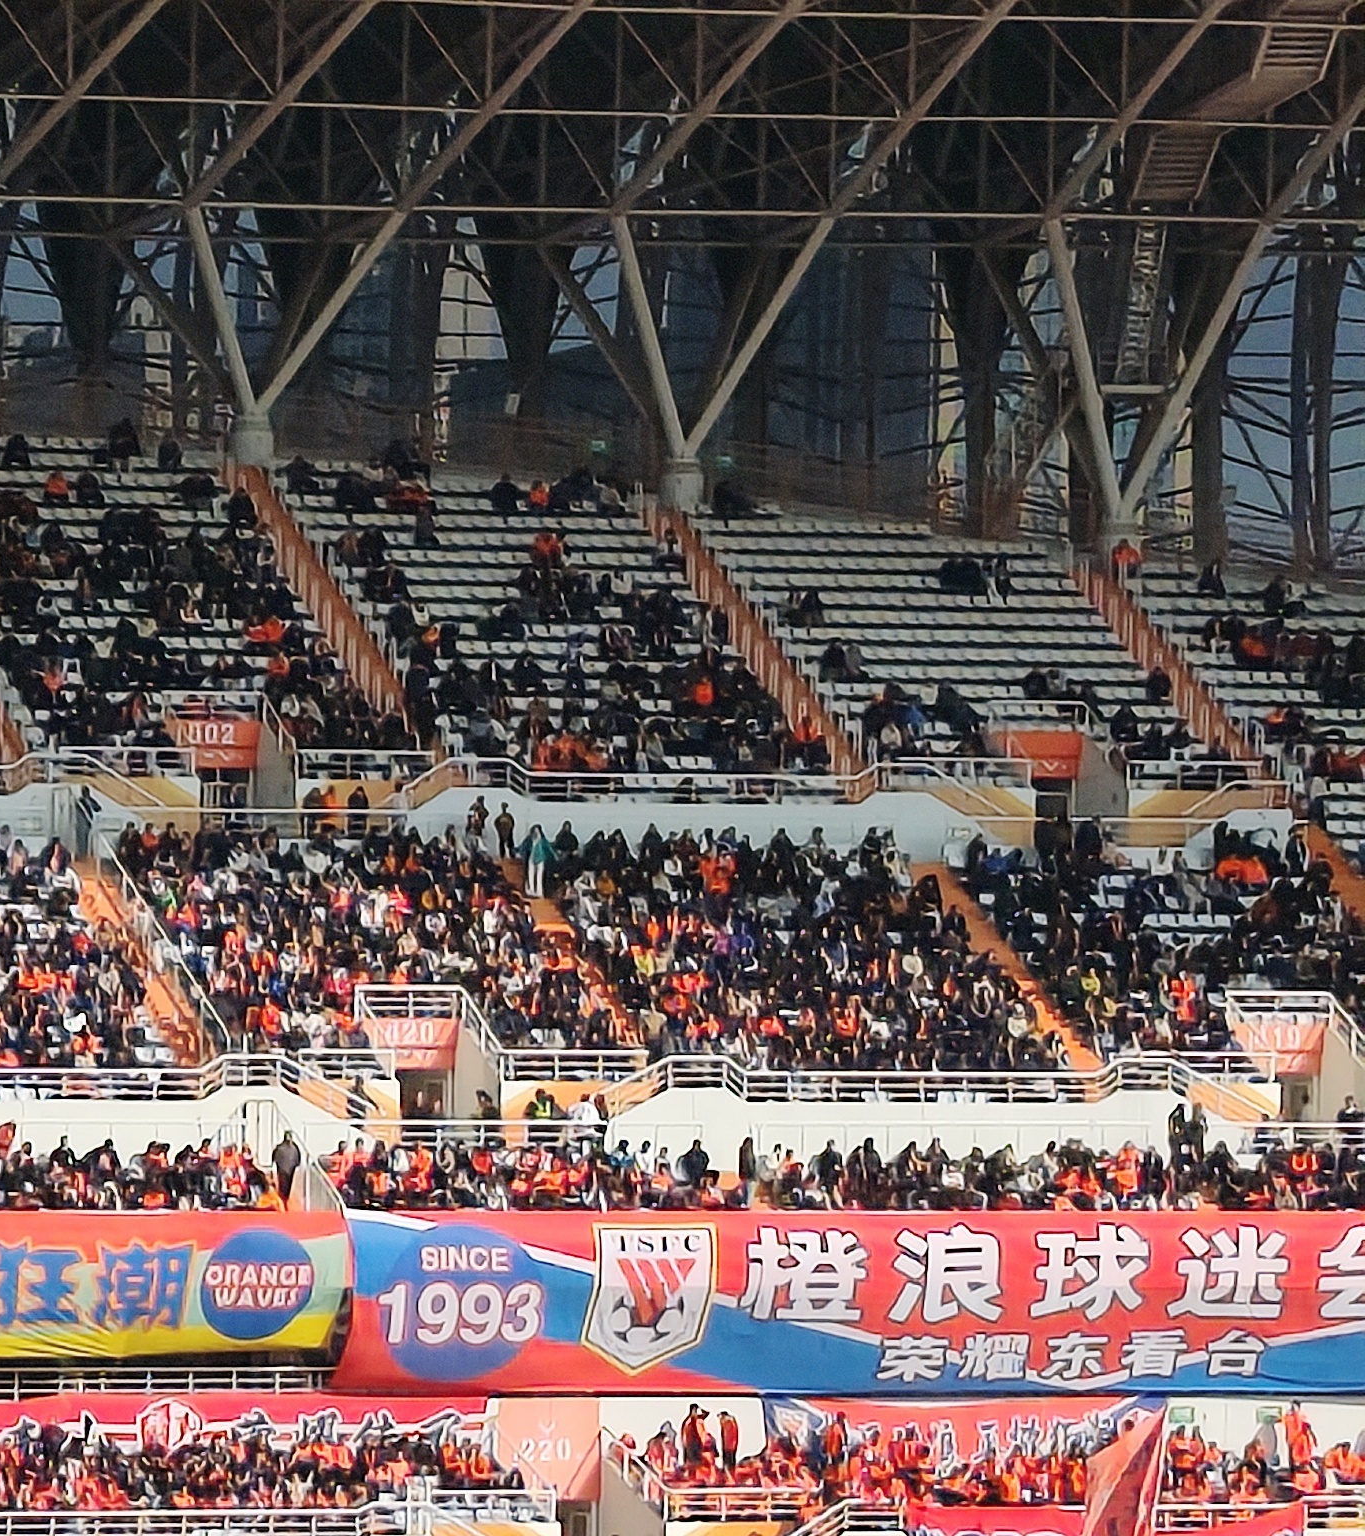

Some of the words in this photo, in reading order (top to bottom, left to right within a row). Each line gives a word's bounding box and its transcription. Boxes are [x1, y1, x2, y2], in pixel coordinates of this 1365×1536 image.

[420, 1245, 510, 1273] SINCE
[205, 1263, 313, 1288] ORANGE
[378, 1281, 544, 1346] 1993
[875, 1329, 1271, 1383] 荣耀东看台
[520, 1437, 572, 1462] 220
